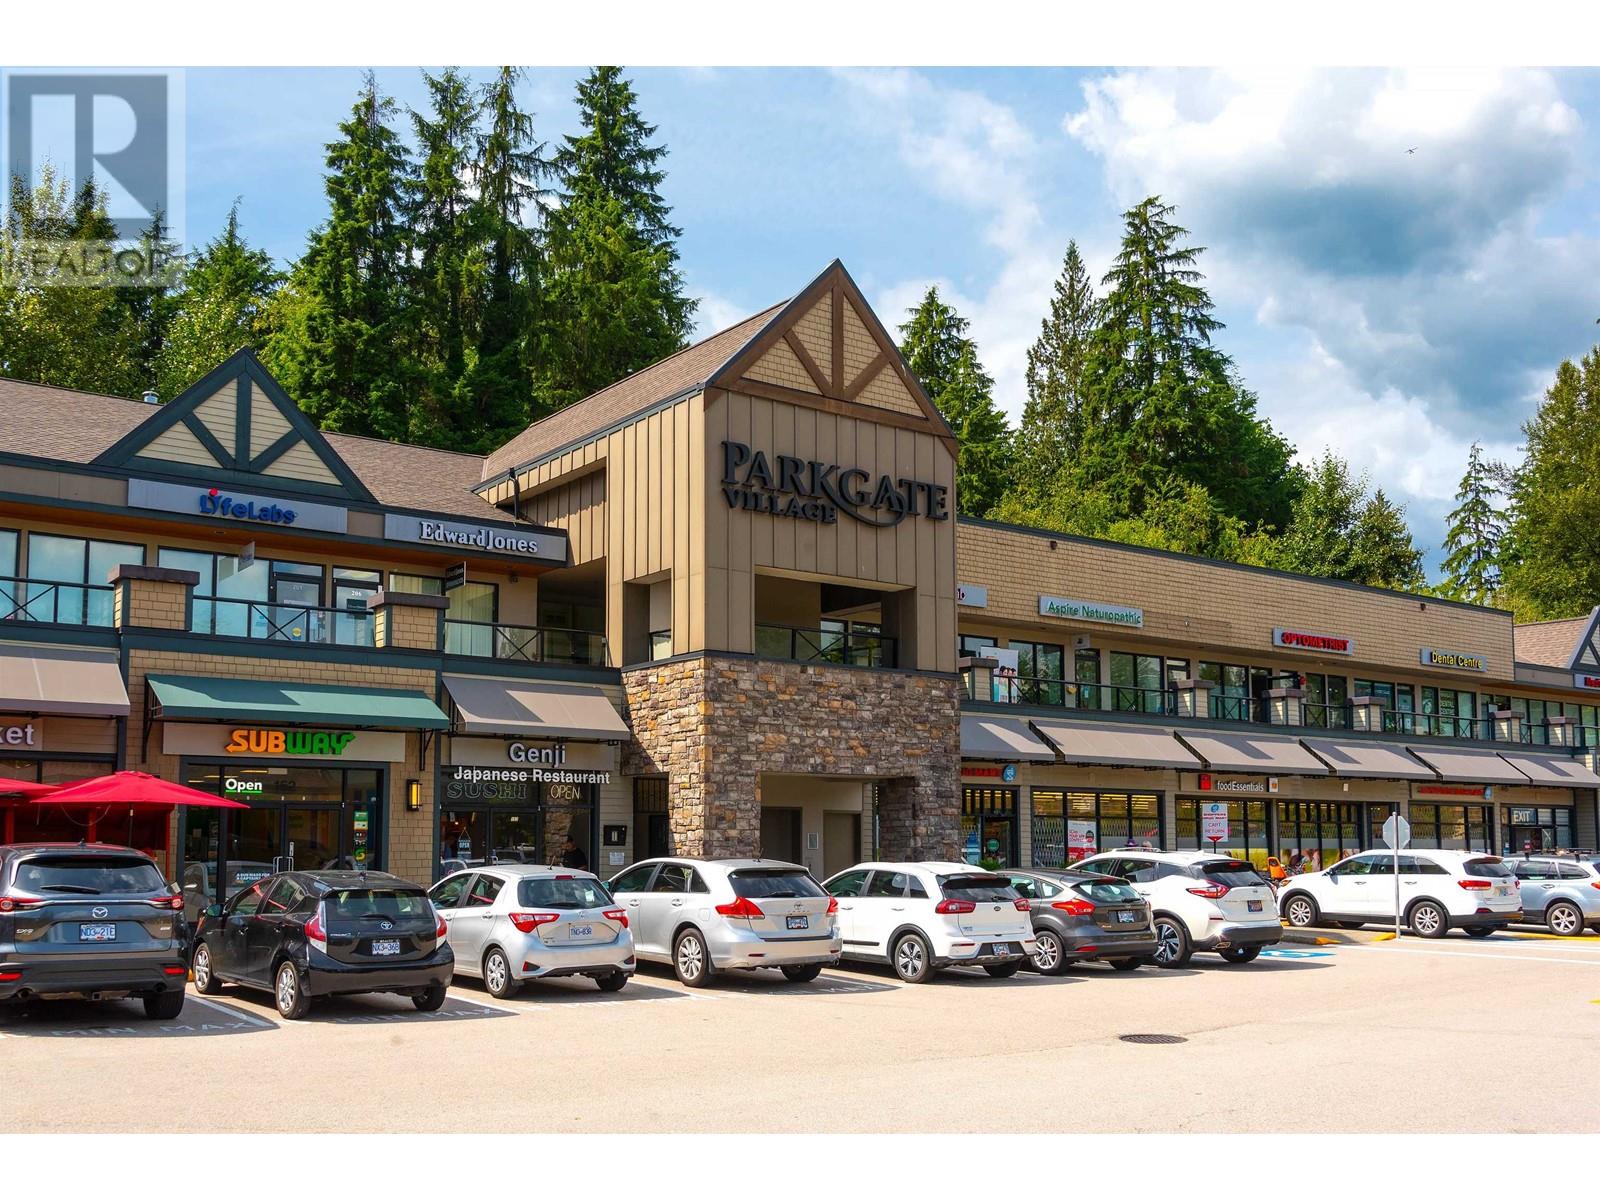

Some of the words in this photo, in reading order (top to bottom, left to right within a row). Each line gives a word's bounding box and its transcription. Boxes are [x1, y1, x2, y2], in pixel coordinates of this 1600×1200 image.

[721, 440, 949, 527] PARKGATE
[722, 487, 837, 523] VILLAGE
[1047, 600, 1080, 616] Aspire
[1081, 605, 1142, 624] Naturopathic
[1431, 651, 1457, 666] Dental
[1457, 655, 1483, 669] Centre
[225, 729, 356, 755] SUBWAY
[509, 742, 567, 768] Genji
[454, 766, 528, 783] Japanese
[532, 769, 610, 784] Restaurant
[225, 778, 263, 793] Open
[447, 781, 528, 800] SUSHI
[550, 784, 581, 800] OPEN
[1513, 810, 1531, 822] EXIT
